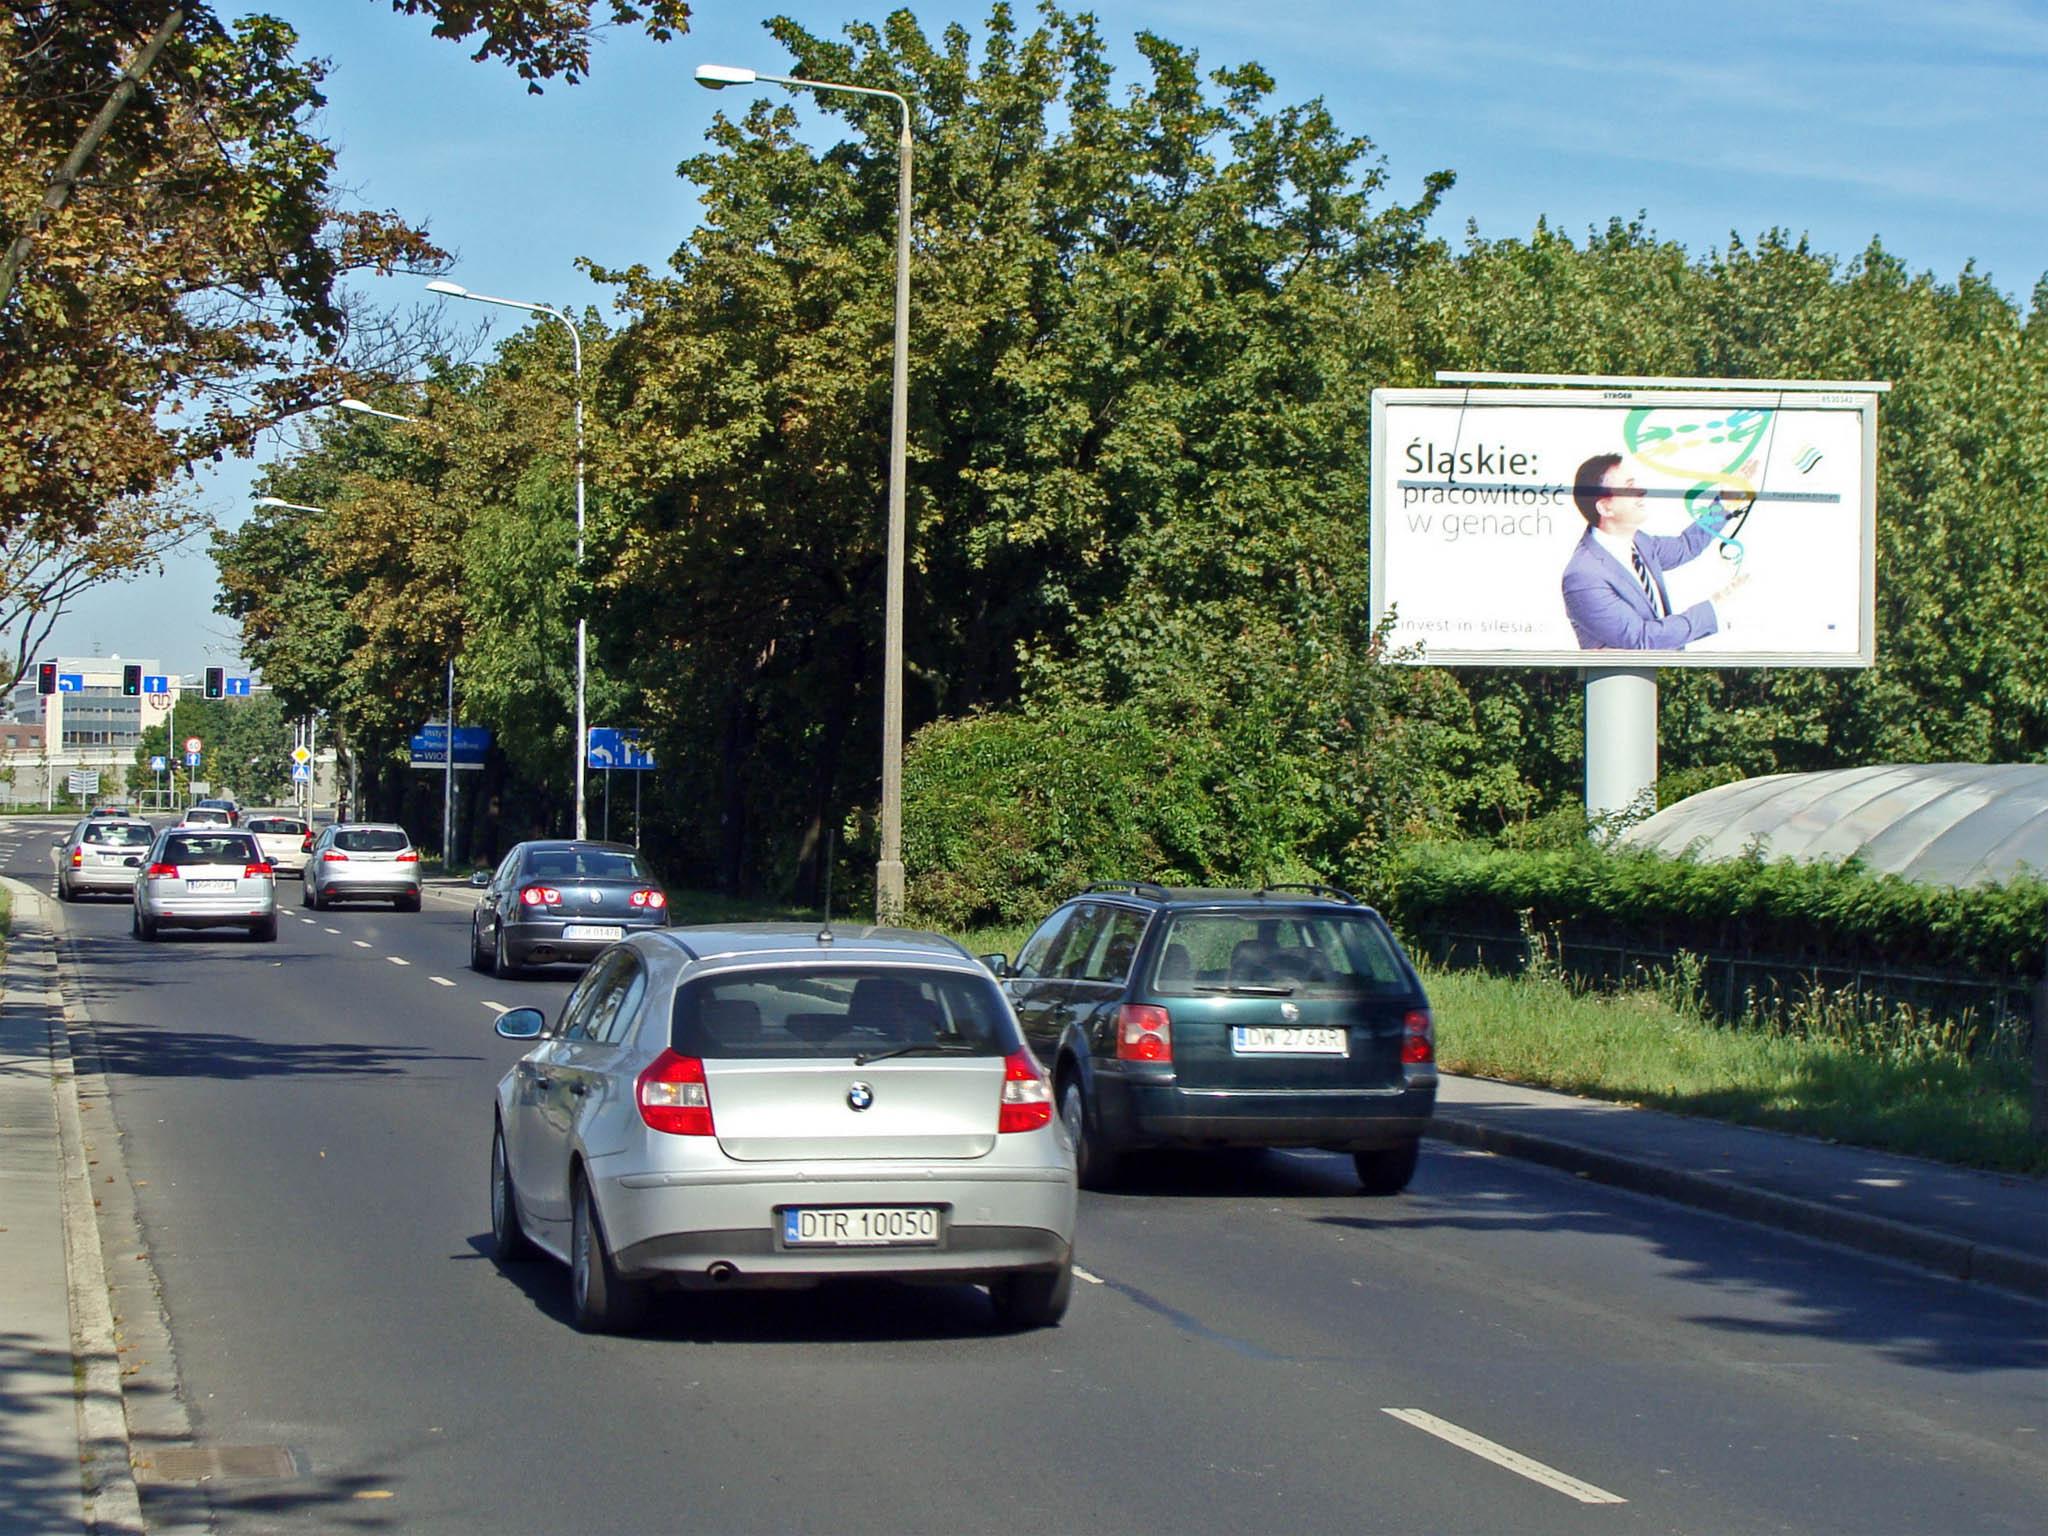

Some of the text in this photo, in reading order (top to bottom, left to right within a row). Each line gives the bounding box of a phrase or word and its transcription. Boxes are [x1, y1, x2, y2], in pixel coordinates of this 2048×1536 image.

[1405, 437, 1538, 484] Śląskie:
[1403, 483, 1565, 509] pracowitość
[1407, 508, 1553, 542] w genach
[801, 1211, 933, 1237] DTR 10050
